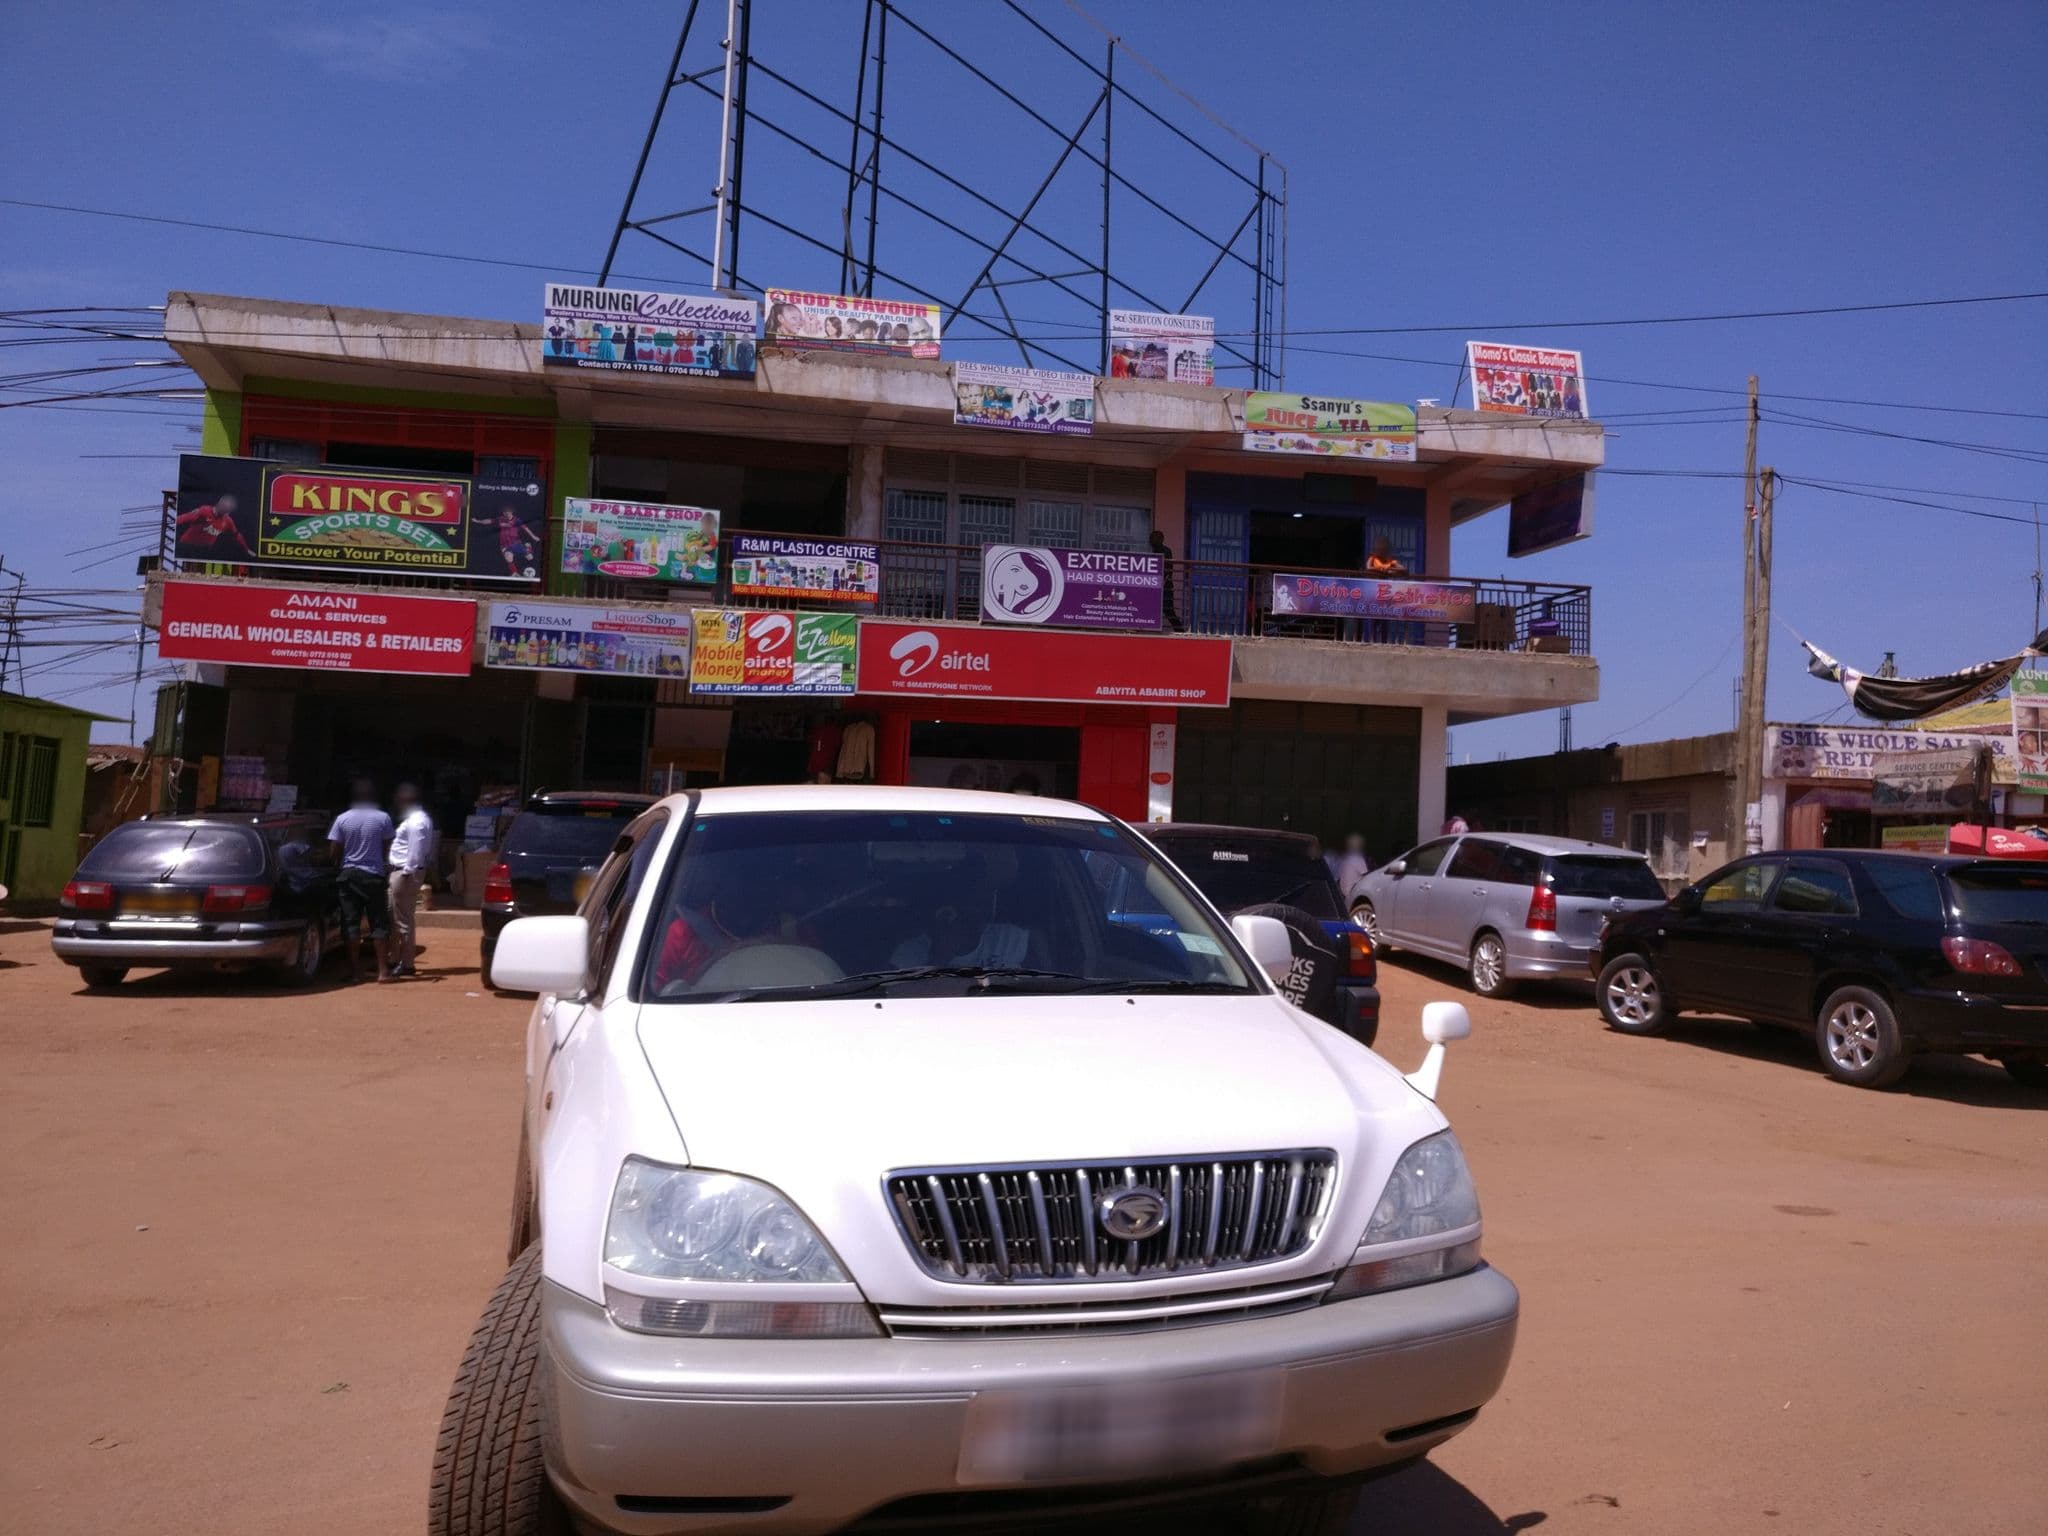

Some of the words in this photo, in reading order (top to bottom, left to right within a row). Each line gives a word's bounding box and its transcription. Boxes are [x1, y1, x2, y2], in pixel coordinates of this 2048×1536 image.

[552, 288, 638, 312] MURUNGI
[636, 294, 752, 323] Collections
[788, 292, 848, 310] GOD'S
[853, 298, 928, 318] FAVOUR
[804, 307, 836, 316] UNISEX
[839, 310, 872, 320] BEAUTY
[874, 315, 913, 323] PARLOUR
[1163, 317, 1201, 329] CONSULTS
[1509, 349, 1537, 363] Classic
[1539, 352, 1575, 369] Boutique
[980, 365, 1008, 374] WHOLE
[1033, 370, 1057, 379] VIDEO
[1060, 372, 1092, 381] LIBRARY
[1301, 397, 1362, 416] Ssanyu's
[1265, 408, 1318, 428] JUICE
[1338, 419, 1371, 432] TEA
[292, 483, 445, 518] KINGS
[624, 505, 661, 519] BABY
[665, 510, 703, 521] SHOP
[295, 512, 390, 541] SPORTS
[396, 523, 443, 549] BET
[267, 543, 340, 559] Discover
[343, 548, 380, 560] Your
[384, 550, 457, 565] Potential
[741, 539, 769, 552] R&M
[773, 542, 824, 556] PLASTIC
[827, 545, 876, 559] CENTRE
[1067, 553, 1158, 573] EXTREME
[1067, 572, 1093, 583] HAIR
[1097, 574, 1158, 586] SOLUTIONS
[1296, 577, 1362, 599] Divine
[286, 593, 358, 609] AMANI
[1319, 600, 1355, 614] Salon
[1357, 604, 1366, 614] &
[270, 608, 321, 621] GLOBAL
[325, 612, 387, 624] SERVICES
[523, 615, 572, 626] PRESAM
[168, 622, 243, 641] GENERAL
[247, 626, 362, 647] WHOLESALERS
[366, 635, 377, 648] &
[381, 635, 462, 652] RETAILERS
[271, 648, 309, 657] CONTACTS:
[694, 646, 742, 661] Mobile
[745, 656, 793, 669] airtel
[940, 652, 990, 671] airtel
[694, 662, 742, 678] Money
[748, 669, 790, 678] money
[892, 680, 906, 689] THE
[907, 681, 958, 691] SMARTPHONE
[959, 684, 992, 692] NETWORK
[1096, 686, 1137, 697] ABAYITA
[1138, 687, 1178, 698] ABABIRI
[1180, 689, 1206, 699] SHOP
[1779, 730, 1830, 747] SMK
[1837, 733, 1918, 751] WHOLE
[1991, 741, 2006, 756] &
[1894, 762, 1928, 771] SERVICE
[1929, 762, 1961, 770] CENTER
